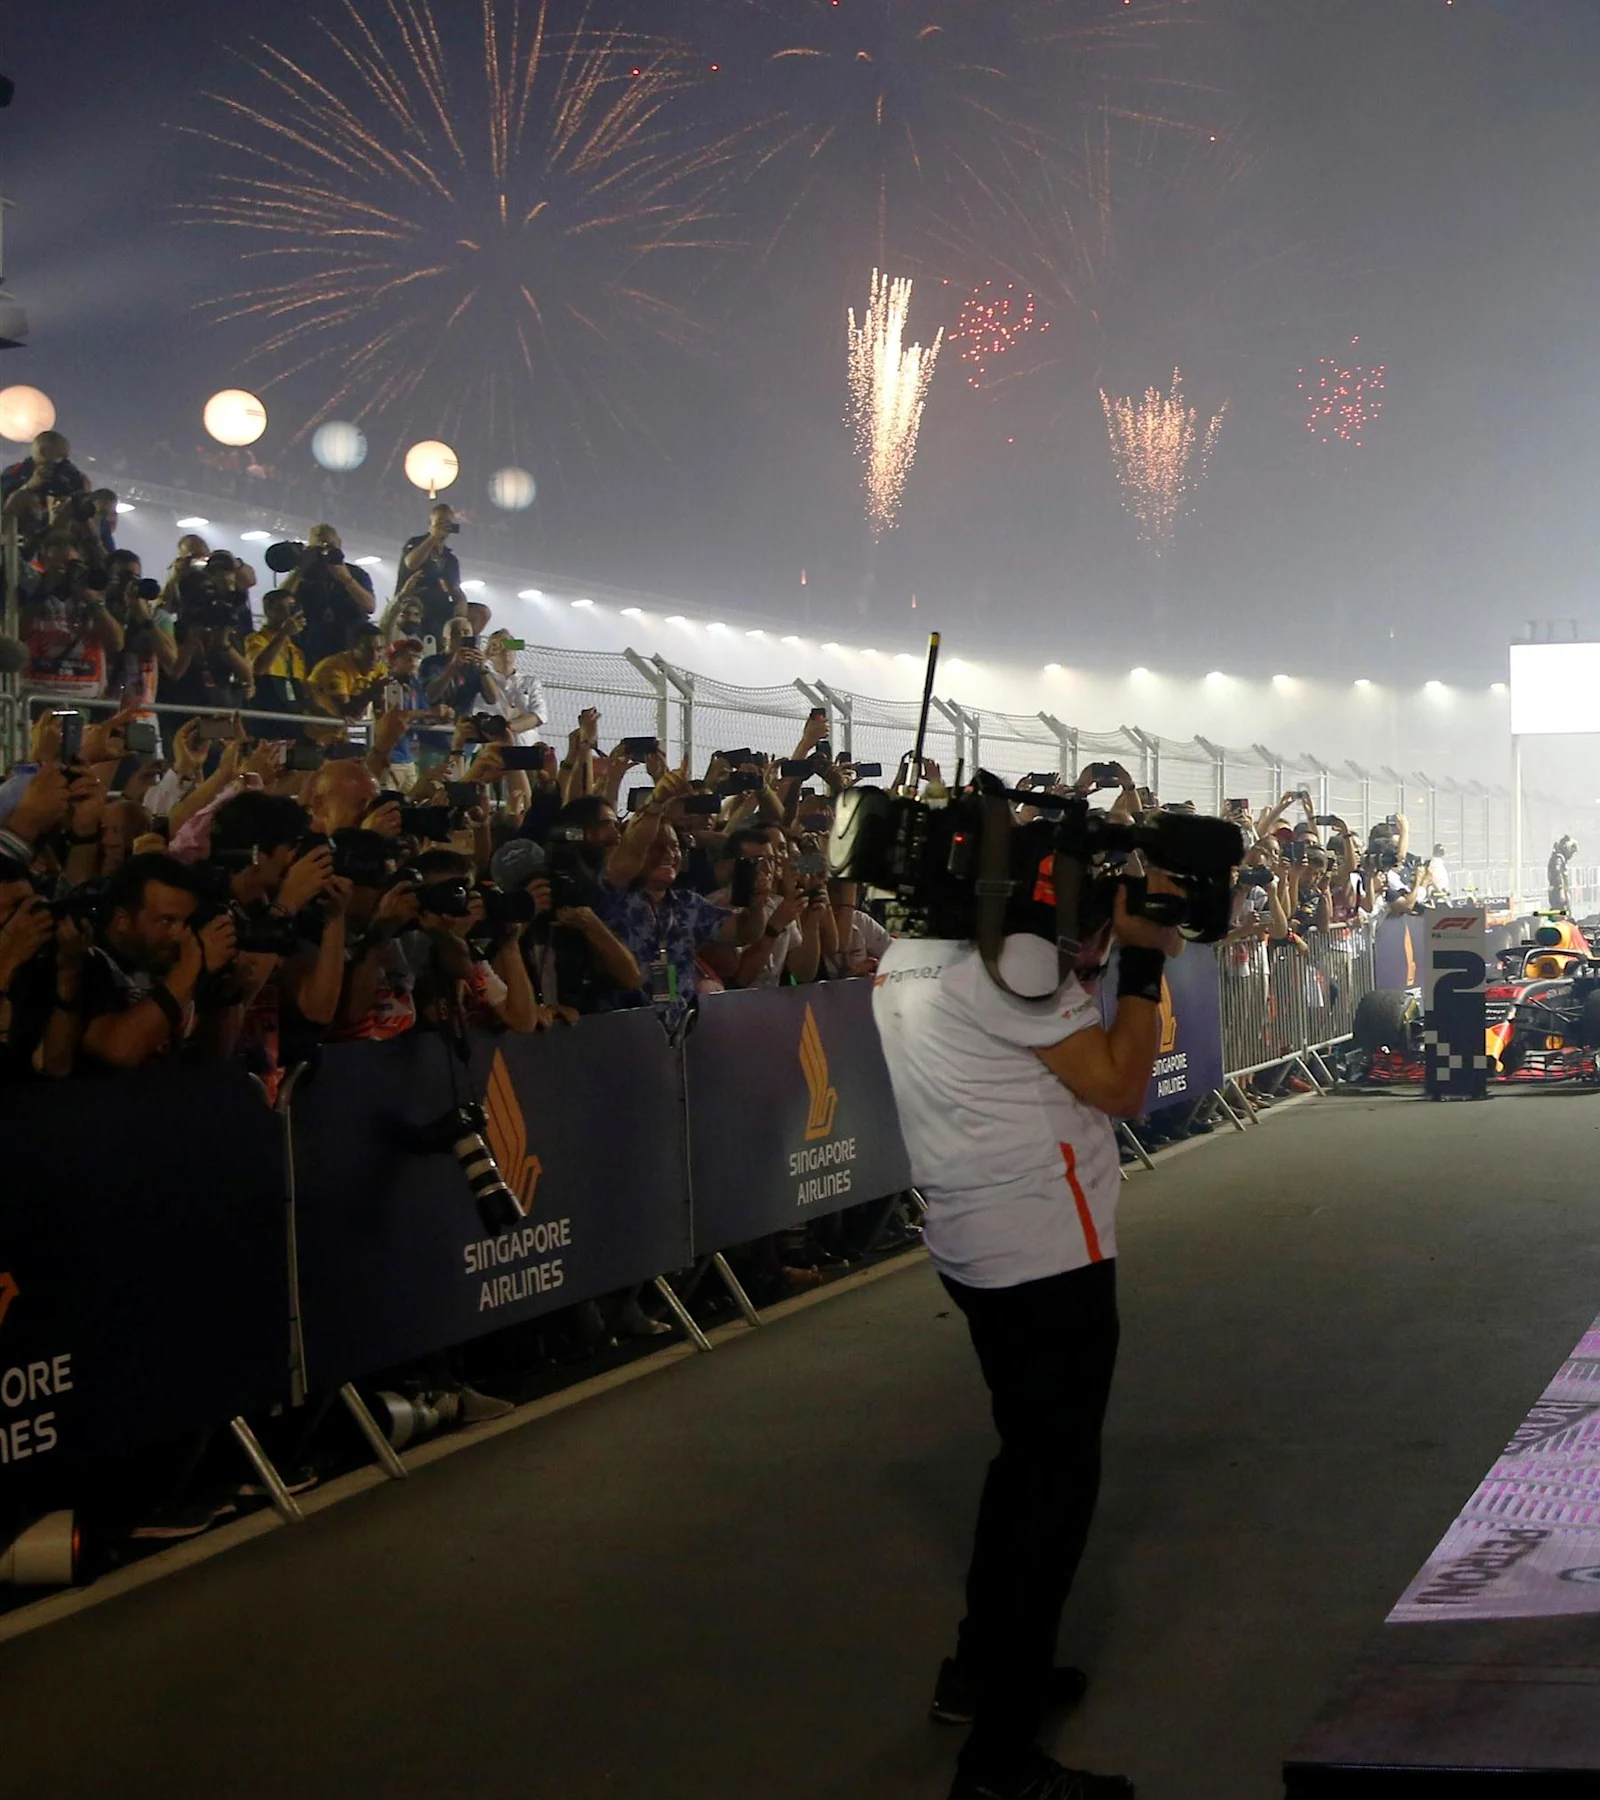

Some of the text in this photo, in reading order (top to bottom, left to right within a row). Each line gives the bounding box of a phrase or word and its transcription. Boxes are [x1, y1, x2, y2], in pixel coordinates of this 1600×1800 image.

[1157, 1074, 1188, 1098] AIRLINES
[788, 1137, 856, 1176] SINGAPORE
[797, 1169, 852, 1206] AIRLINES
[463, 1218, 572, 1275] SINGAPORE
[479, 1258, 564, 1312] AIRLINES
